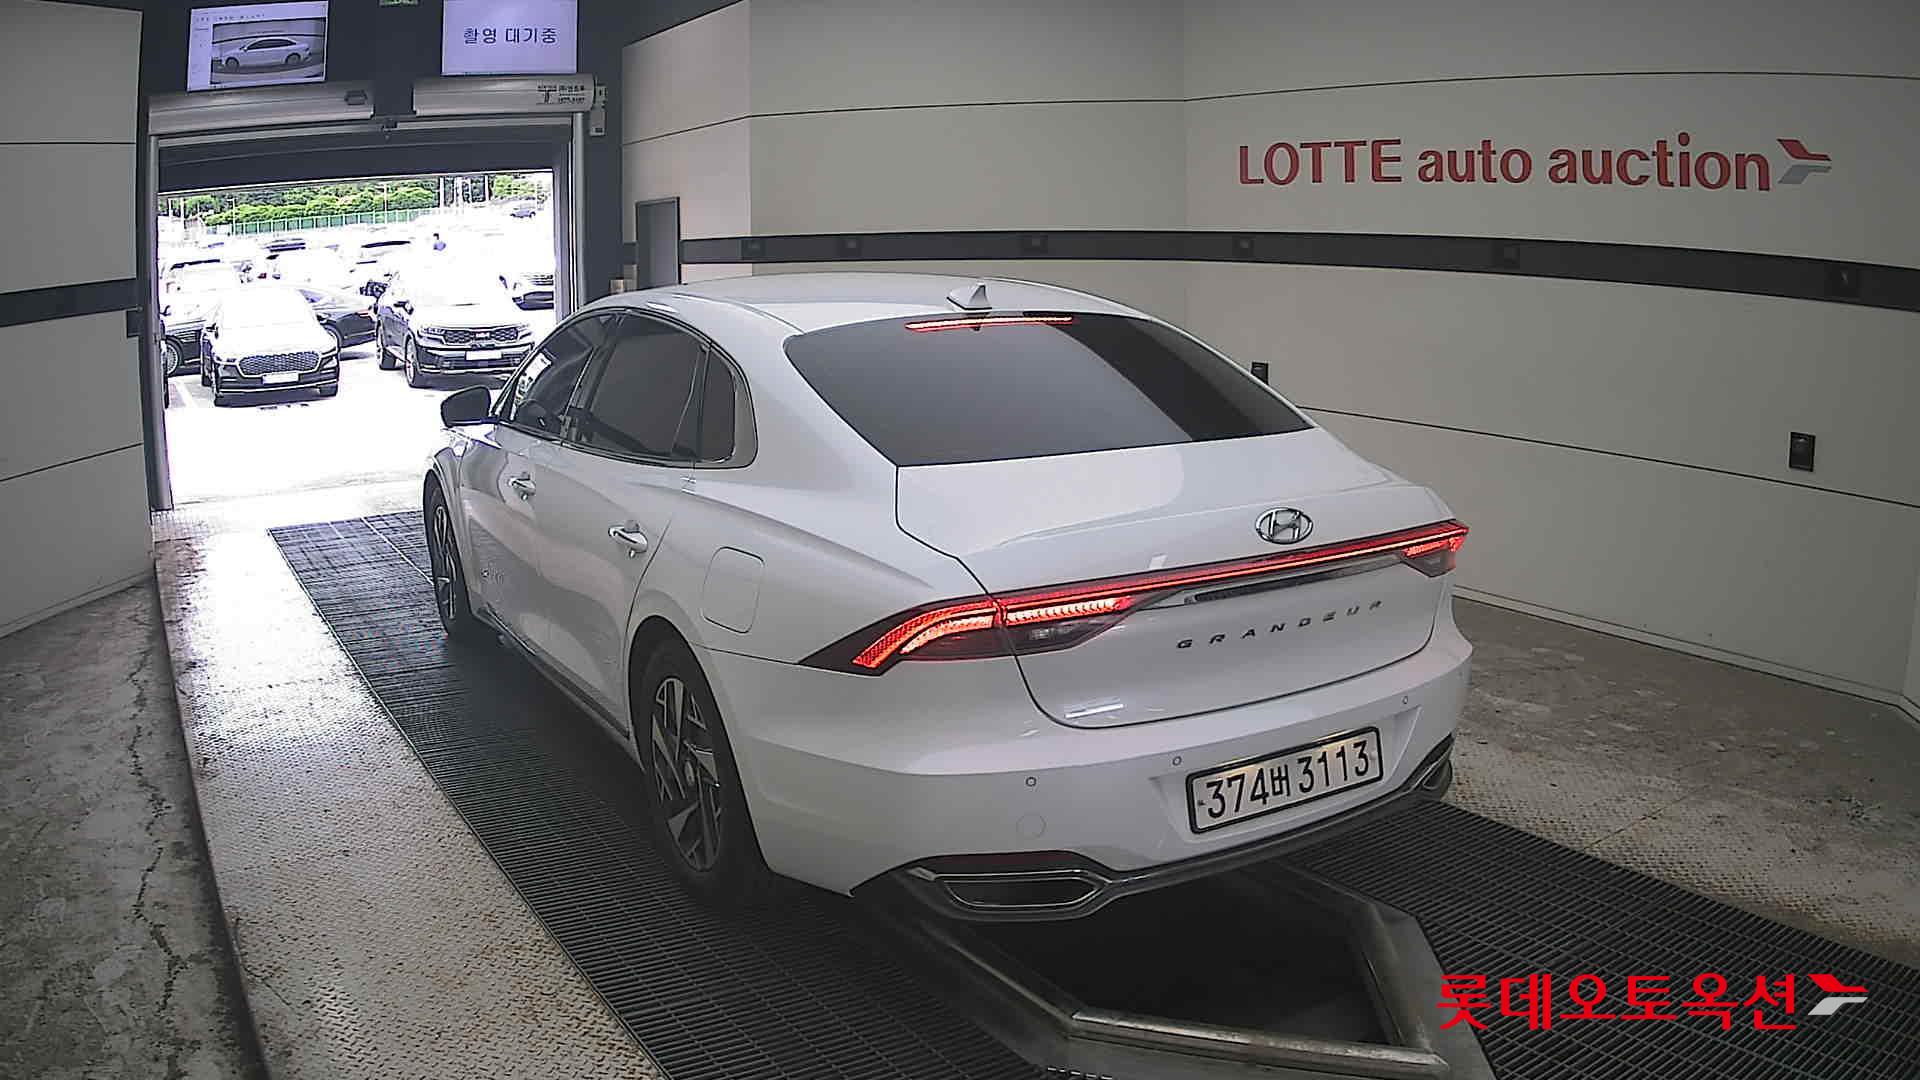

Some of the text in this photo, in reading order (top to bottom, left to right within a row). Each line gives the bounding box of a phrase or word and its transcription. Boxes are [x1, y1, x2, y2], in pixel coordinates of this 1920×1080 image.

[463, 27, 558, 44] 촬영 대기중
[1238, 131, 1770, 192] LOTTE auto auction
[1176, 600, 1382, 649] GRANDEUR
[1206, 740, 1369, 819] 374버 3113
